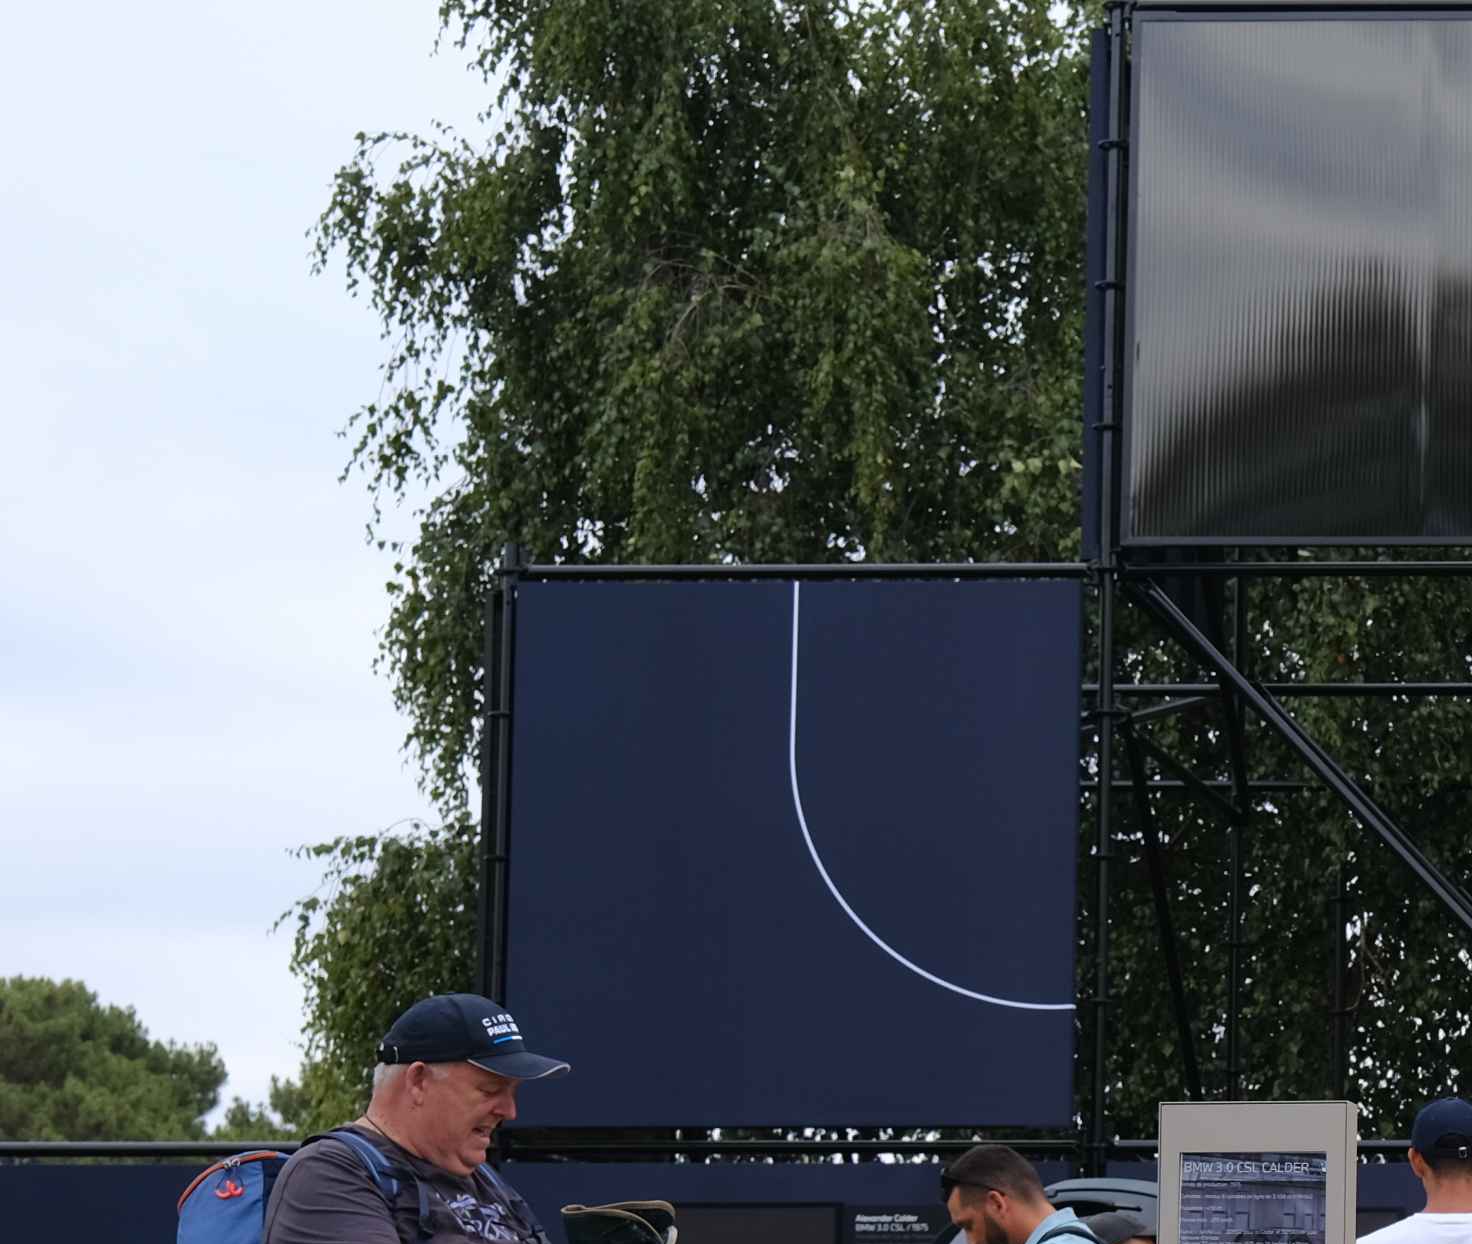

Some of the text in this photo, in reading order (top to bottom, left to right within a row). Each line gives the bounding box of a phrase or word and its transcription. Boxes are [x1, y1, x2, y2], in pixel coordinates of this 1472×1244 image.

[1183, 1161, 1310, 1174] BMW 3.0 CSL CALDER
[855, 1214, 918, 1222] Alexander Calder
[855, 1223, 875, 1232] BMW
